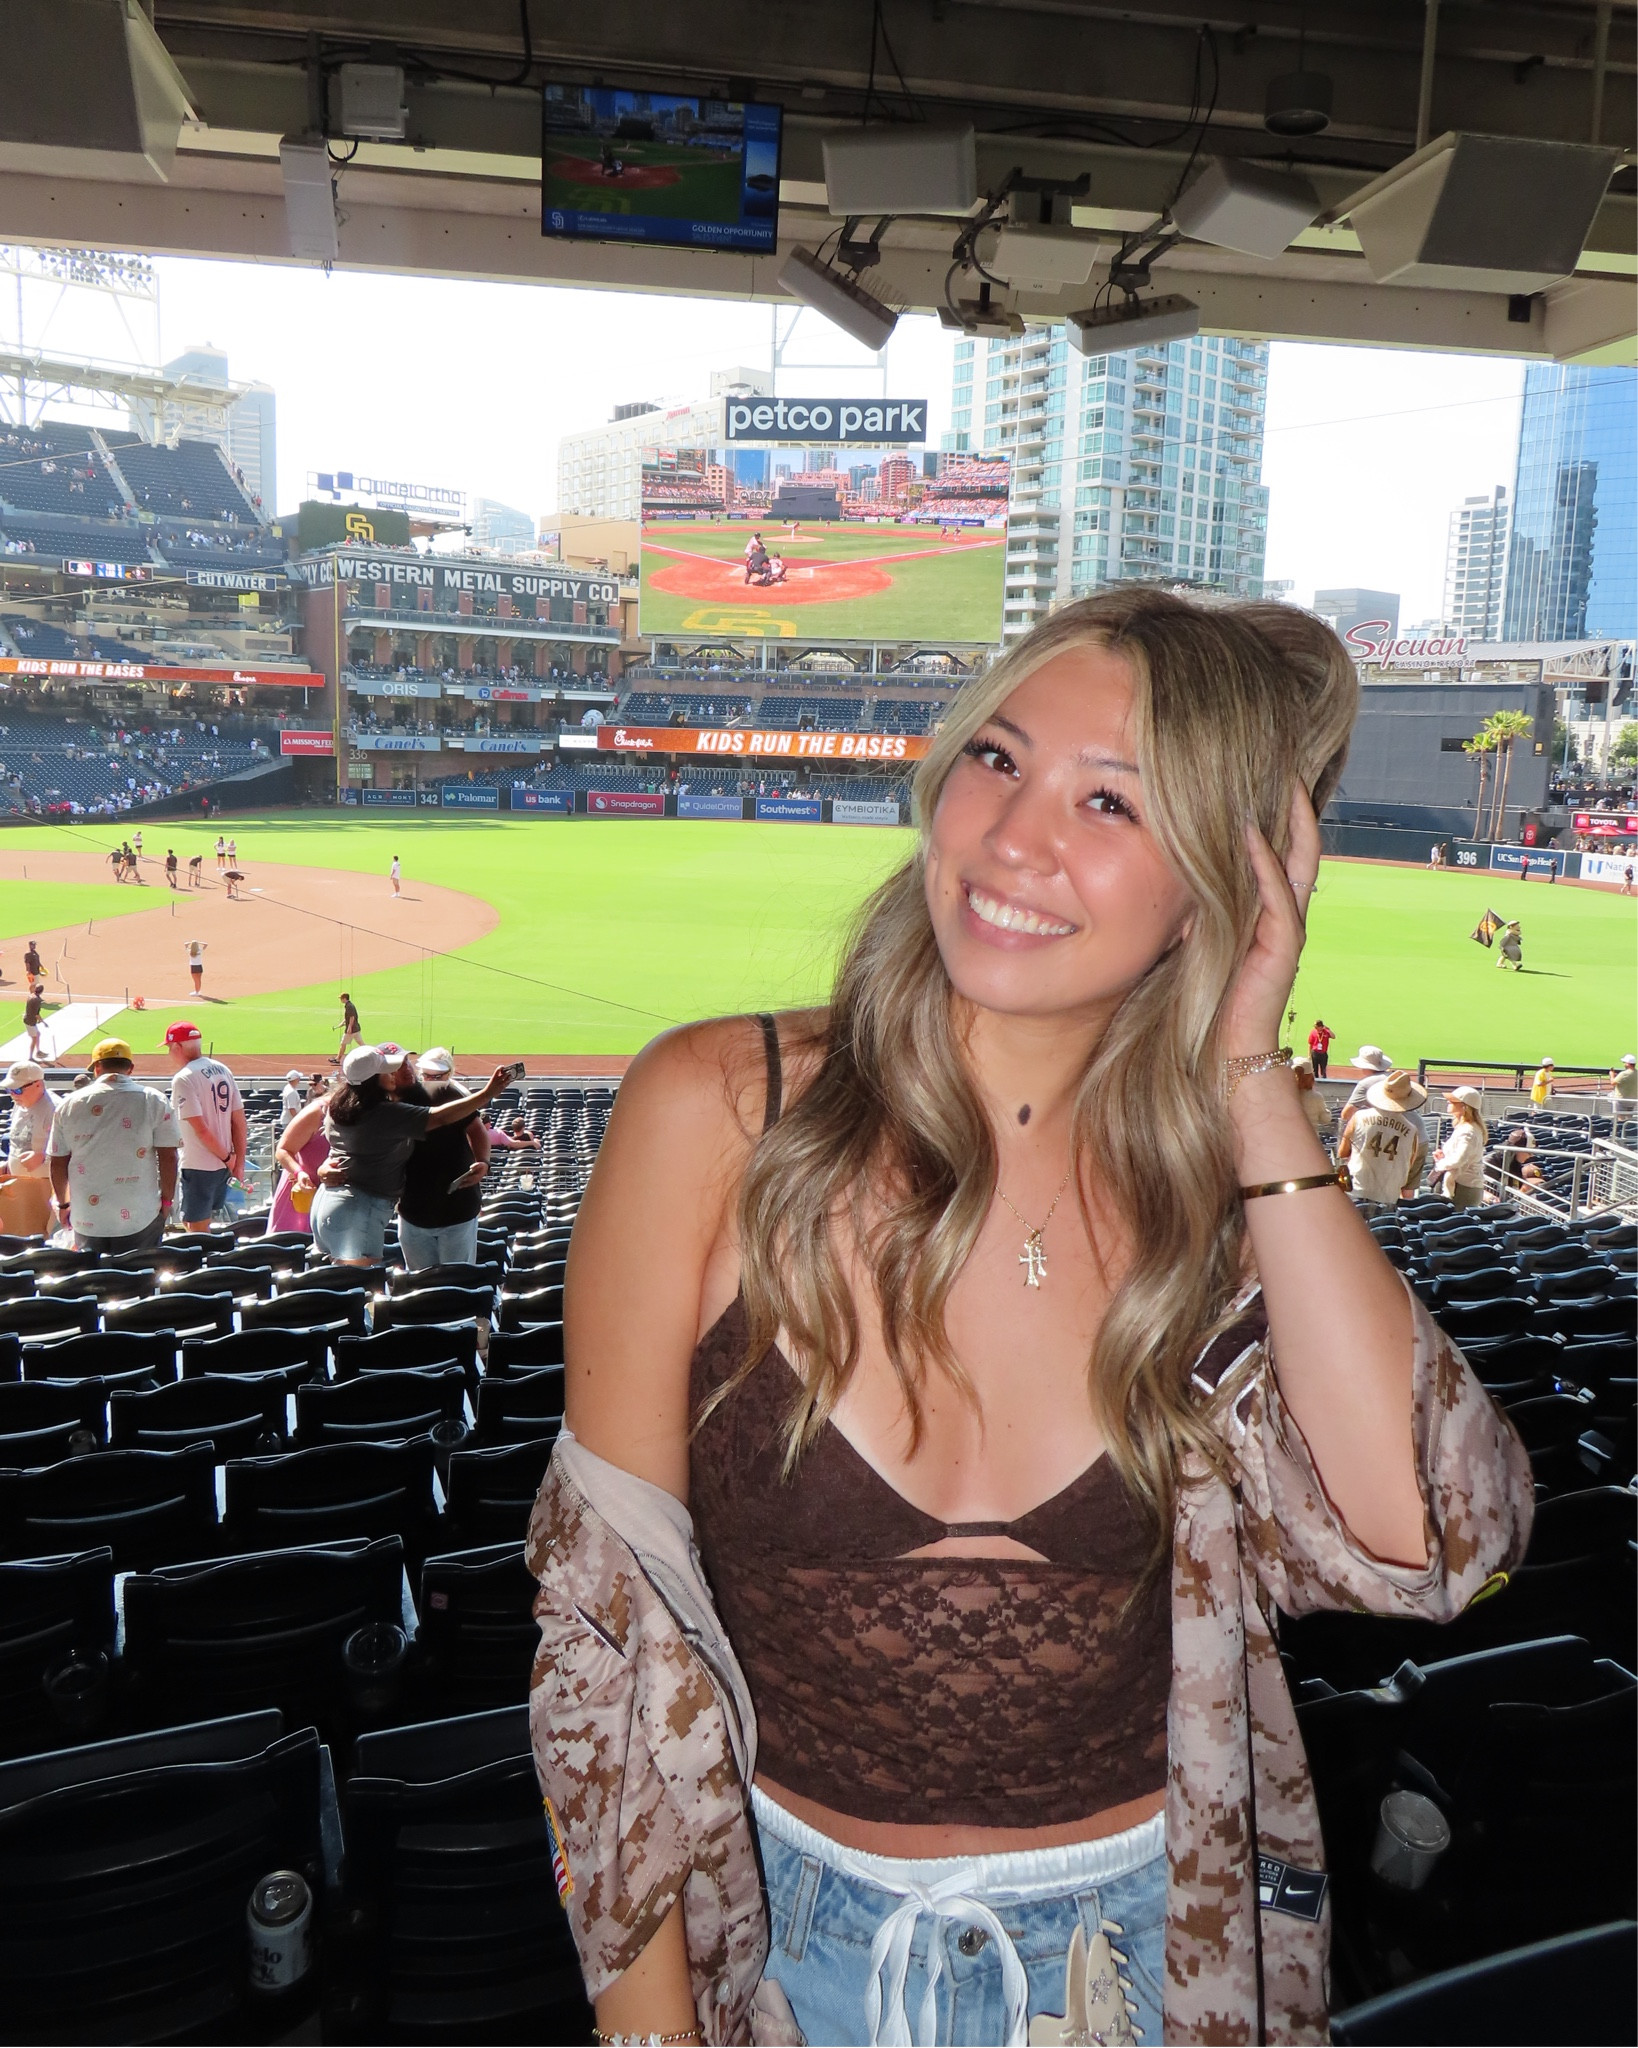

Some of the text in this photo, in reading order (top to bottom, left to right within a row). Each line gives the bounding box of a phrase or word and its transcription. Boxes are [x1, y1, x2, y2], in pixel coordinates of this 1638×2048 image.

[692, 224, 773, 238] GOLDEN OPPORTUNITY
[728, 400, 923, 440] petco park
[197, 571, 267, 590] CUTWATER
[338, 559, 618, 603] WESTERN METAL SUPPLY CO.
[1344, 620, 1471, 670] Sycuan
[17, 660, 144, 677] KIDS RUN THE BASES
[1394, 660, 1476, 669] CASINO RESORT
[382, 683, 419, 696] ORIS
[292, 738, 321, 746] MISSION
[374, 737, 426, 750] Canel's
[480, 740, 527, 752] Canel's
[696, 732, 907, 758] KIDS RUN THE BASES
[349, 749, 368, 760] 336
[420, 794, 438, 805] 342
[457, 792, 497, 803] Palomar
[525, 794, 561, 805] us bank
[610, 800, 657, 809] Snapdragon
[692, 802, 740, 812] QuidelOrtho
[760, 803, 811, 815] Southwest
[835, 804, 896, 814] CYMBIOTIKA
[1456, 851, 1477, 866] 396
[211, 1080, 230, 1114] 19
[1363, 1115, 1411, 1137] MUSGROVE
[1370, 1130, 1400, 1161] 44
